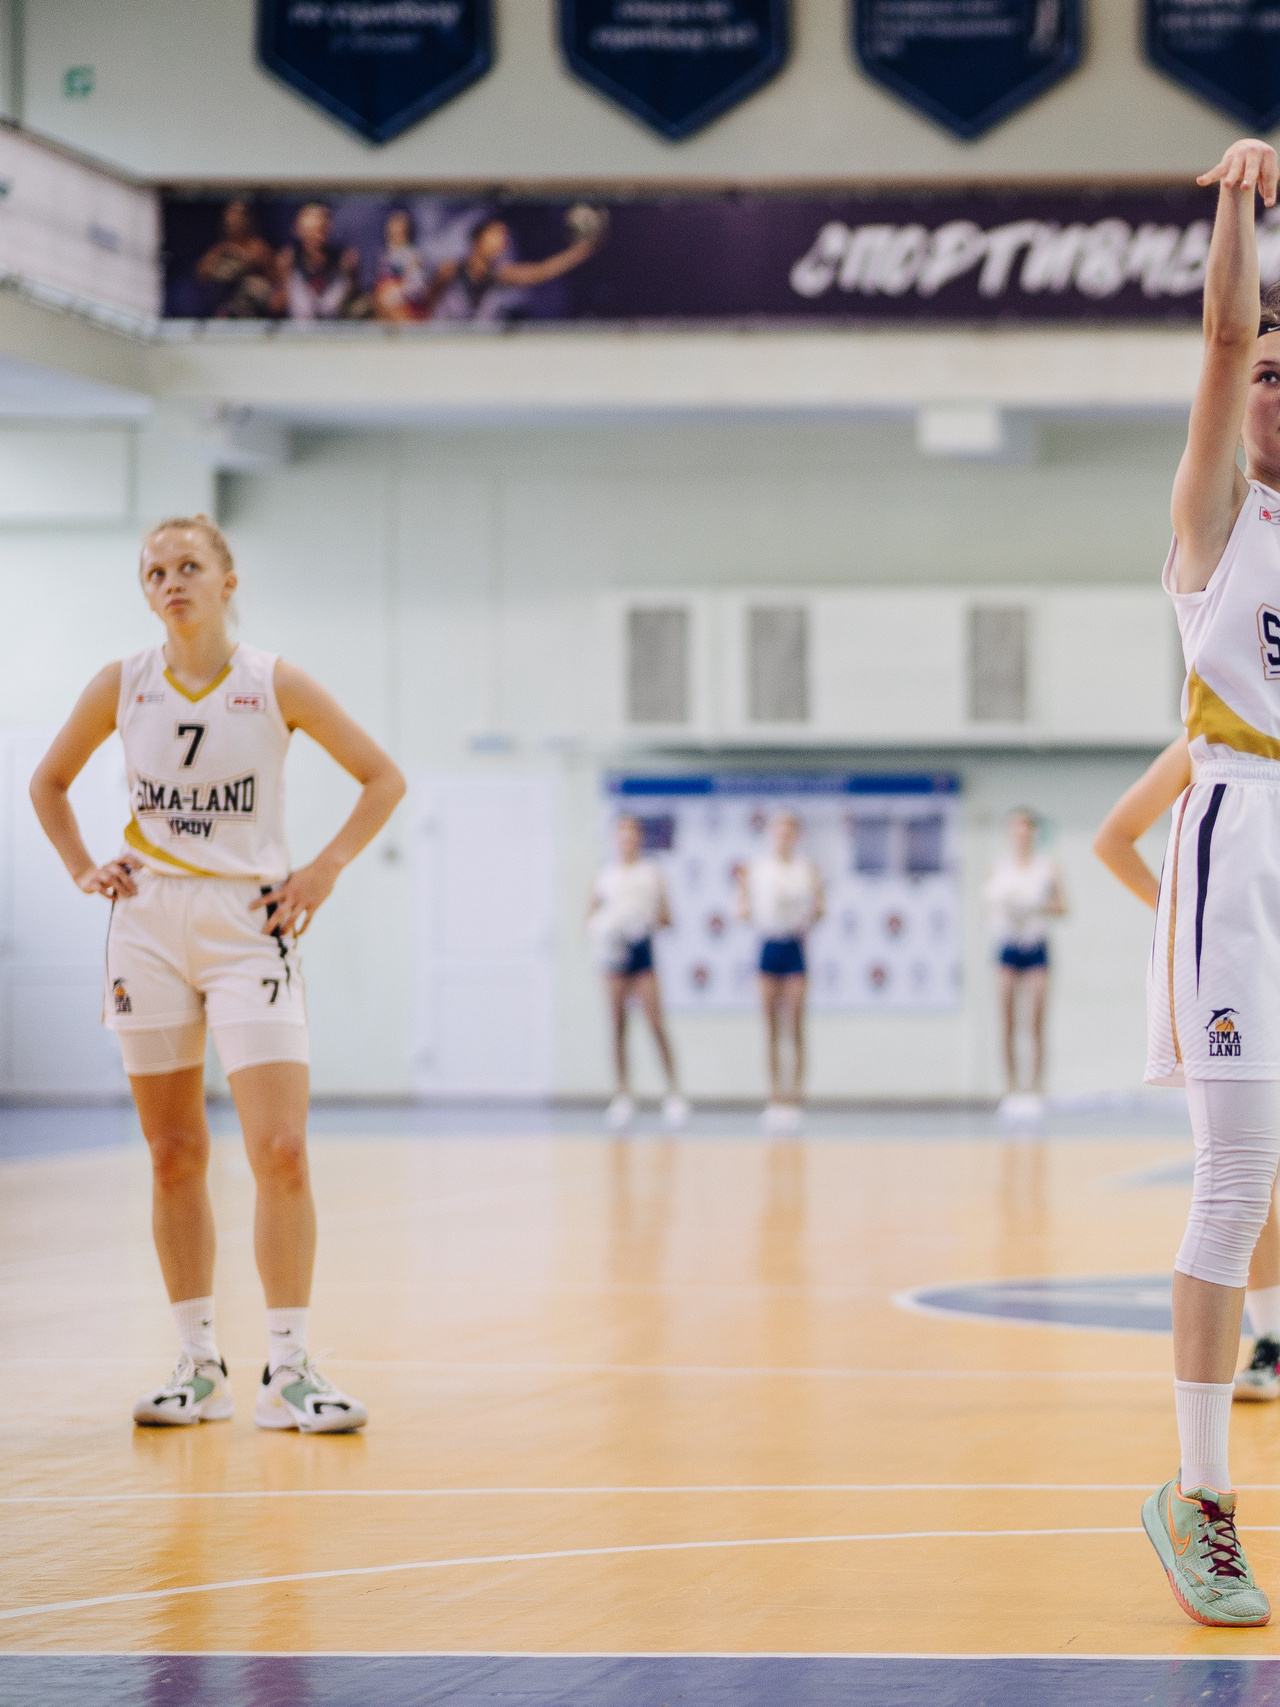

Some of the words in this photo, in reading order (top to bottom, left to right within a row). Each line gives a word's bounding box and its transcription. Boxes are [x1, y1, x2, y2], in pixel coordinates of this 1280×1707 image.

[177, 723, 205, 767] 7
[262, 978, 280, 1003] 7
[1209, 1044, 1241, 1057] LAND
